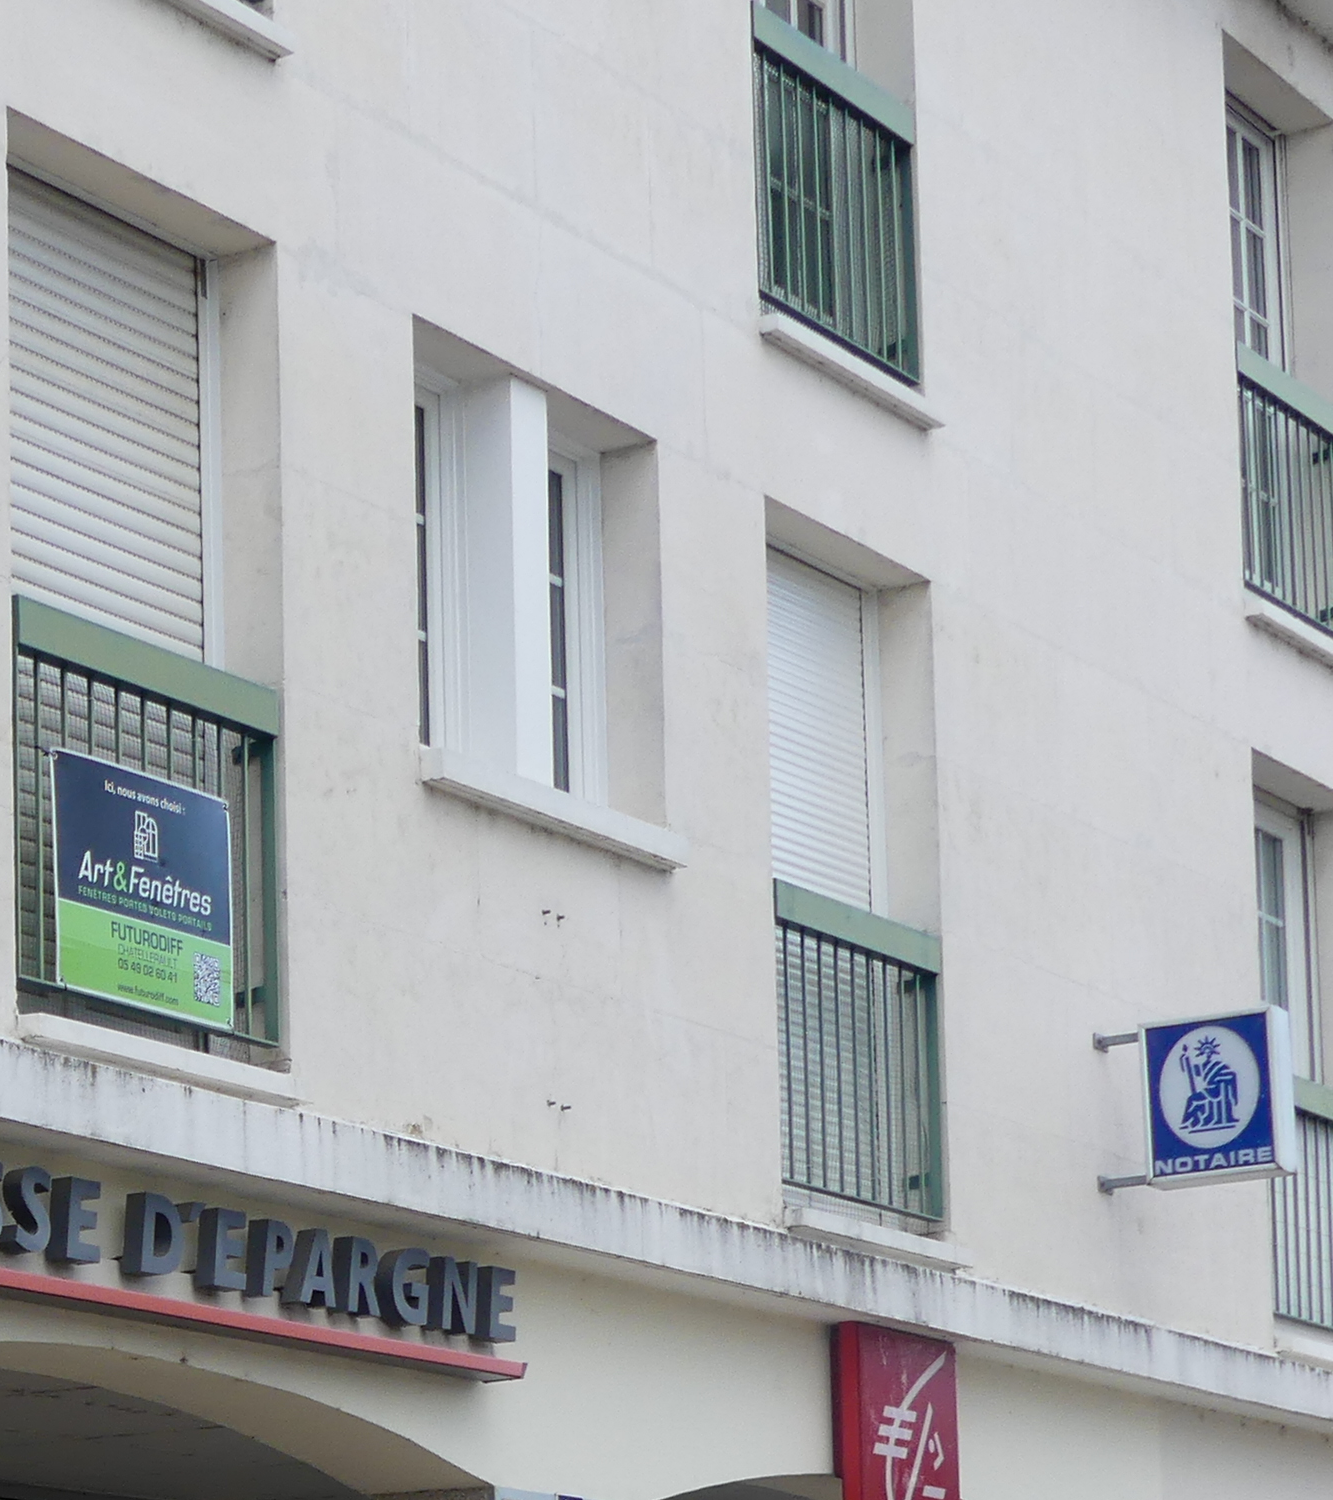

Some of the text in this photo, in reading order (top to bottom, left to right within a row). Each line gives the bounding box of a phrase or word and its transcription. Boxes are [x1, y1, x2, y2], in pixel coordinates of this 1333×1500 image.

[104, 779, 116, 795] Ici,
[117, 786, 136, 800] nous
[137, 792, 159, 807] avons
[160, 797, 182, 814] choisi
[78, 850, 212, 916] Art&Fenêtres
[118, 897, 148, 914] PORTES
[148, 904, 176, 922] VOLETS
[178, 912, 212, 931] PORTAILS
[111, 921, 183, 956] FUTURODIFF
[117, 957, 129, 971] 05
[142, 964, 154, 978] 02
[167, 971, 178, 983] 41
[1155, 1147, 1273, 1175] NOTAIRE
[122, 1191, 517, 1343] D'EPARGNE
